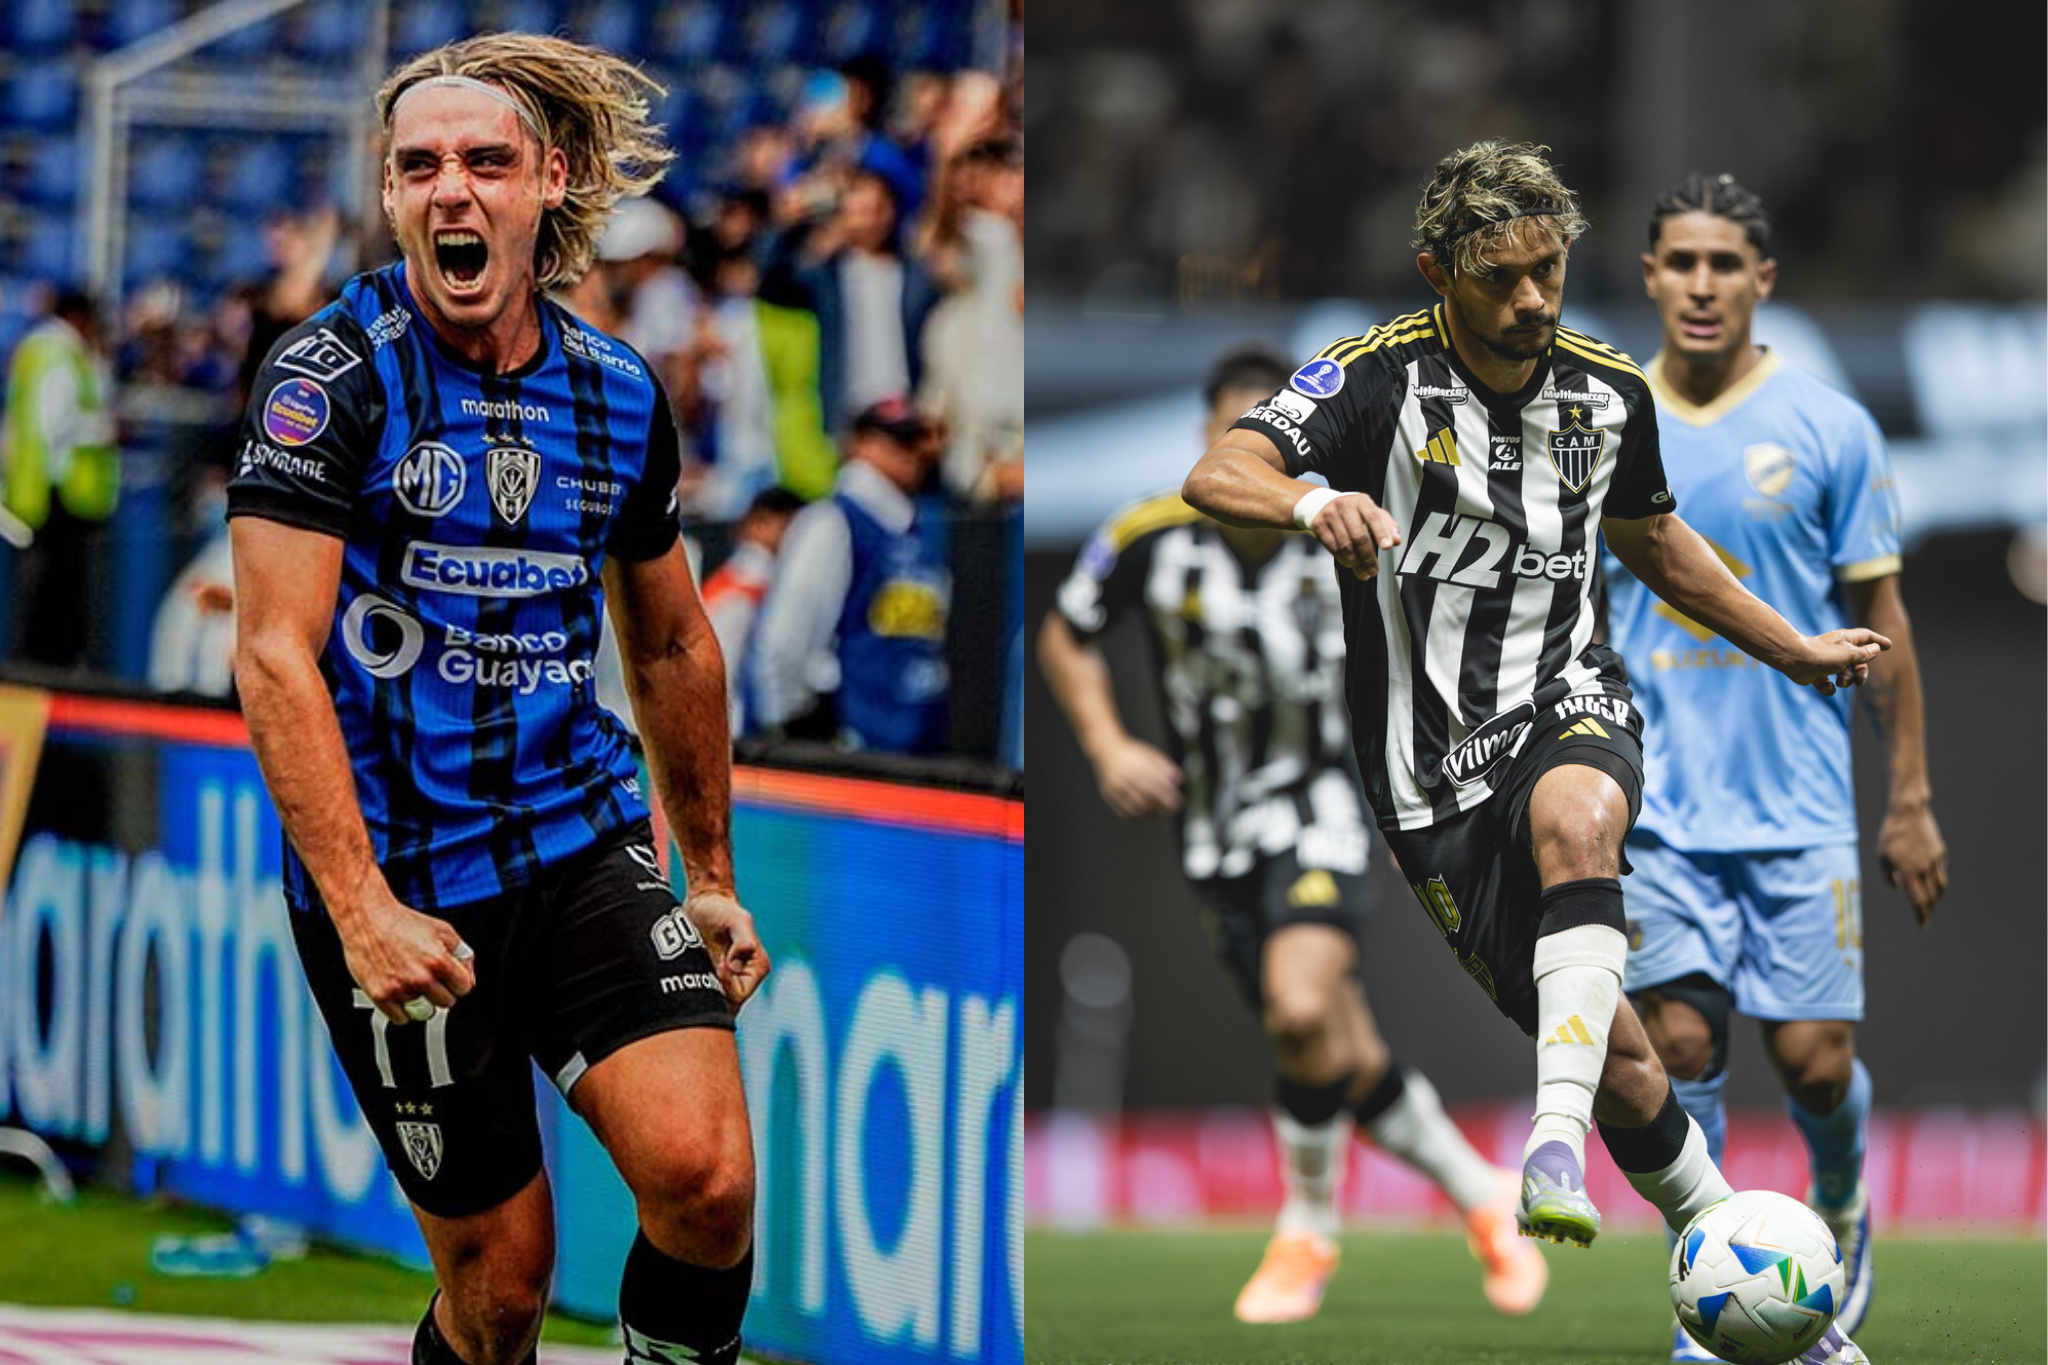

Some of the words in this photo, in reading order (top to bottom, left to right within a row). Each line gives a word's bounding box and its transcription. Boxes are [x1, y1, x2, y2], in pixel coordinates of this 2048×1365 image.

[561, 320, 612, 351] anco
[1411, 384, 1469, 397] ultimarcas
[1542, 389, 1610, 402] Multimarcas
[461, 398, 549, 422] marathon
[1491, 435, 1521, 444] POSTOS
[400, 446, 461, 511] MG
[1489, 461, 1522, 471] ALE
[556, 475, 622, 496] CHUBB
[409, 547, 584, 592] Ecuabet
[444, 622, 568, 653] Banco
[438, 648, 595, 695] Guayaq
[0, 780, 378, 1200] aratho
